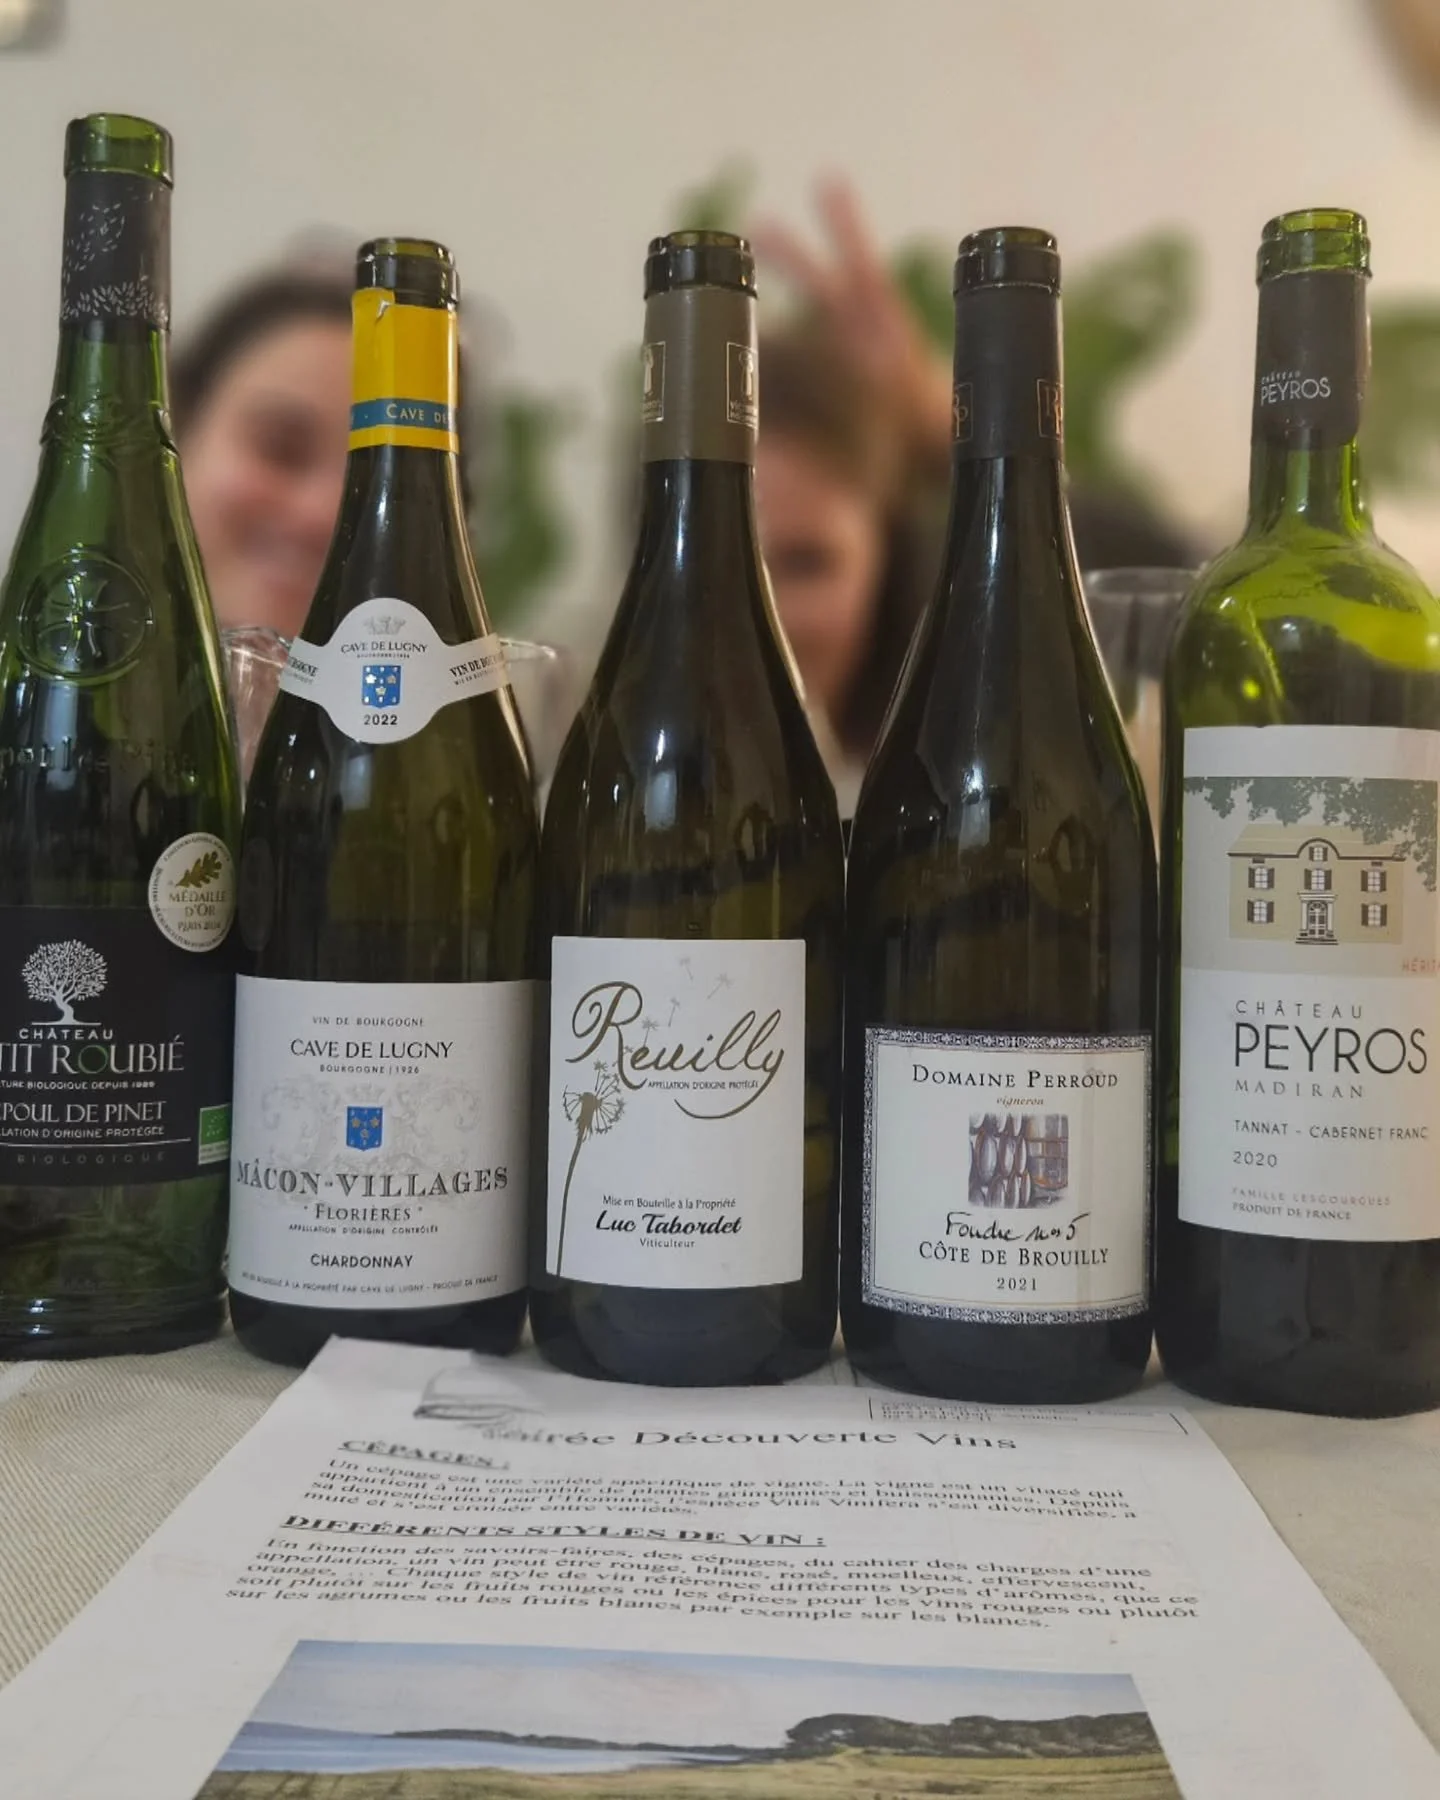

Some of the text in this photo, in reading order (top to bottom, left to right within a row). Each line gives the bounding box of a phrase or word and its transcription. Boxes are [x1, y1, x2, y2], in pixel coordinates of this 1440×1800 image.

[1261, 377, 1331, 406] PEYROS
[341, 641, 428, 654] CAVE DE LUGNY
[363, 714, 398, 726] 2022
[1235, 1000, 1363, 1020] CHÂTEAU
[312, 1016, 424, 1027] VIN DE BOURGOGNE
[19, 1027, 114, 1041] CHÂTEAU
[51, 1034, 186, 1075] ROUBIÉ
[290, 1038, 454, 1059] CAVE DE LUGNY
[565, 981, 784, 1120] Reuilly
[1235, 1022, 1428, 1075] PEYROS
[27, 1081, 88, 1090] BIOLOGIQUE
[648, 1080, 690, 1090] APPELLATION
[912, 1064, 1119, 1089] DOMAINE PERROUD
[1234, 1079, 1364, 1098] MADIRAN
[0, 1100, 167, 1123] POUL DE PINET
[0, 1127, 39, 1138] LATION
[42, 1127, 102, 1138] D'ORIGINE
[1234, 1119, 1429, 1140] TANNAT CABERNET FRANC
[1233, 1150, 1278, 1168] 2020
[236, 1158, 509, 1198] MÂCON-VILLAGES
[603, 1194, 736, 1211] Mise en Bouteille à la Propriété
[1232, 1202, 1352, 1221] PRODUIT DE FRANCE
[289, 1223, 337, 1234] APPELLATION
[342, 1226, 385, 1235] D'ORIGINE
[596, 1209, 742, 1234] Luc Tabordet
[639, 1237, 696, 1248] Viticulteur
[310, 1253, 413, 1269] CHARDONNAY
[919, 1241, 1110, 1266] CÔTE DE BROUILLY
[996, 1277, 1038, 1292] 2021
[634, 1431, 897, 1445] Découverte
[915, 1432, 1017, 1449] Vins
[284, 1514, 804, 1545] DIFFÉRENTS STYLES DE VIN
[256, 1551, 399, 1567] appellation,
[408, 1557, 439, 1566] un
[449, 1556, 486, 1567] vin
[494, 1558, 548, 1568] peut
[555, 1558, 601, 1568] être
[610, 1561, 687, 1574] rouge,
[696, 1564, 770, 1579] blanc,
[779, 1569, 839, 1580] rosé,
[848, 1569, 973, 1584] moelleux,
[266, 1538, 299, 1551] En
[308, 1540, 407, 1556] fonction
[415, 1546, 455, 1556] des
[643, 1548, 683, 1560] des
[691, 1549, 796, 1568] cépages,
[804, 1557, 834, 1567] du
[843, 1557, 920, 1568] cahier
[927, 1558, 968, 1570] des
[976, 1561, 1071, 1576] charges
[1079, 1566, 1152, 1577] d'une
[247, 1564, 336, 1577] orange,
[387, 1567, 482, 1580] Chaque
[490, 1569, 549, 1581] style
[558, 1570, 587, 1580] de
[596, 1572, 634, 1582] vin
[901, 1583, 968, 1596] types
[1113, 1594, 1161, 1605] que
[1169, 1596, 1199, 1604] ce
[236, 1574, 1200, 1619] soit plutôt sur les fruits rouges ou les épices pour les vins rouges ou plutôt
[225, 1588, 1052, 1628] sur les agrumes ou les fruits blancs par exemple sur les blancs.
